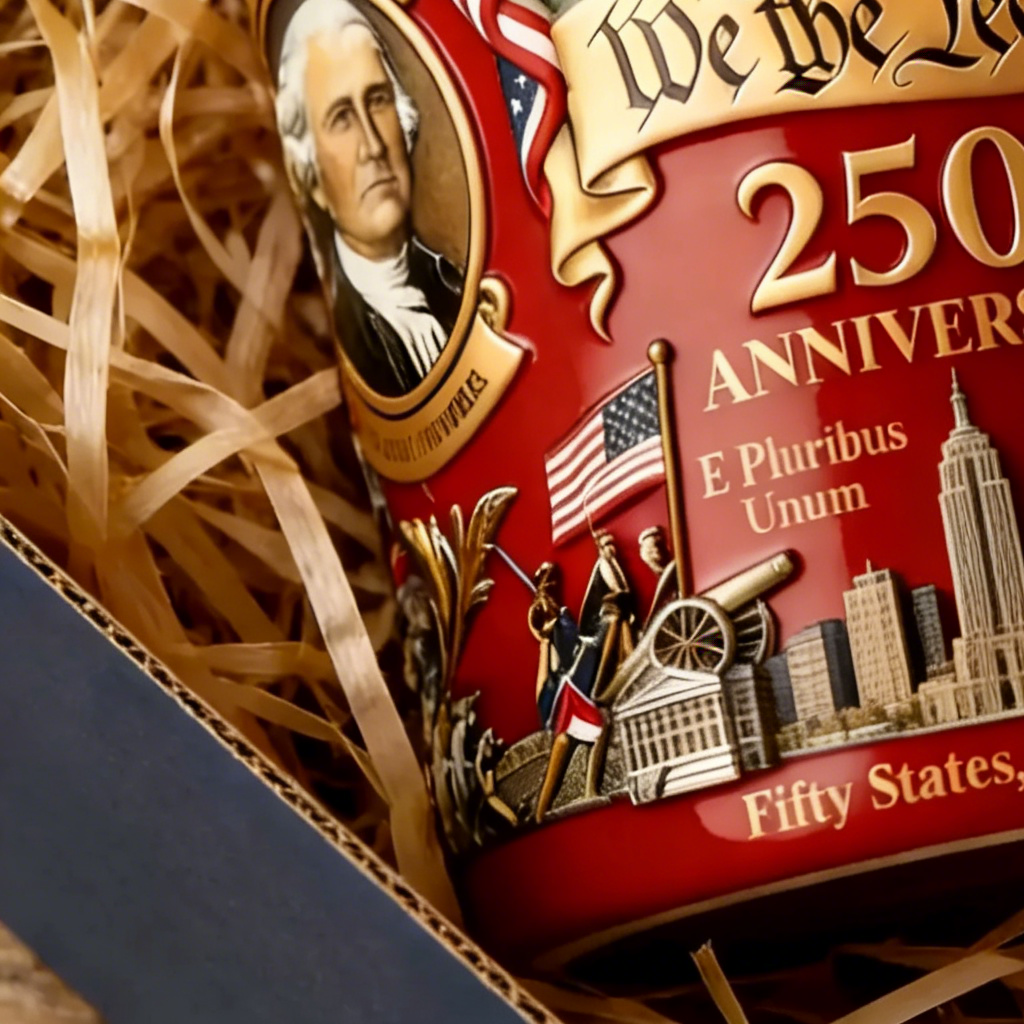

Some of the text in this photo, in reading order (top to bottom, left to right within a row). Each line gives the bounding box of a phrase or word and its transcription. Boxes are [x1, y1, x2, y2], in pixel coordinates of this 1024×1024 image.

[697, 419, 909, 500] E Pluribus
[741, 481, 871, 535] Unum
[742, 778, 855, 842] Fifty
